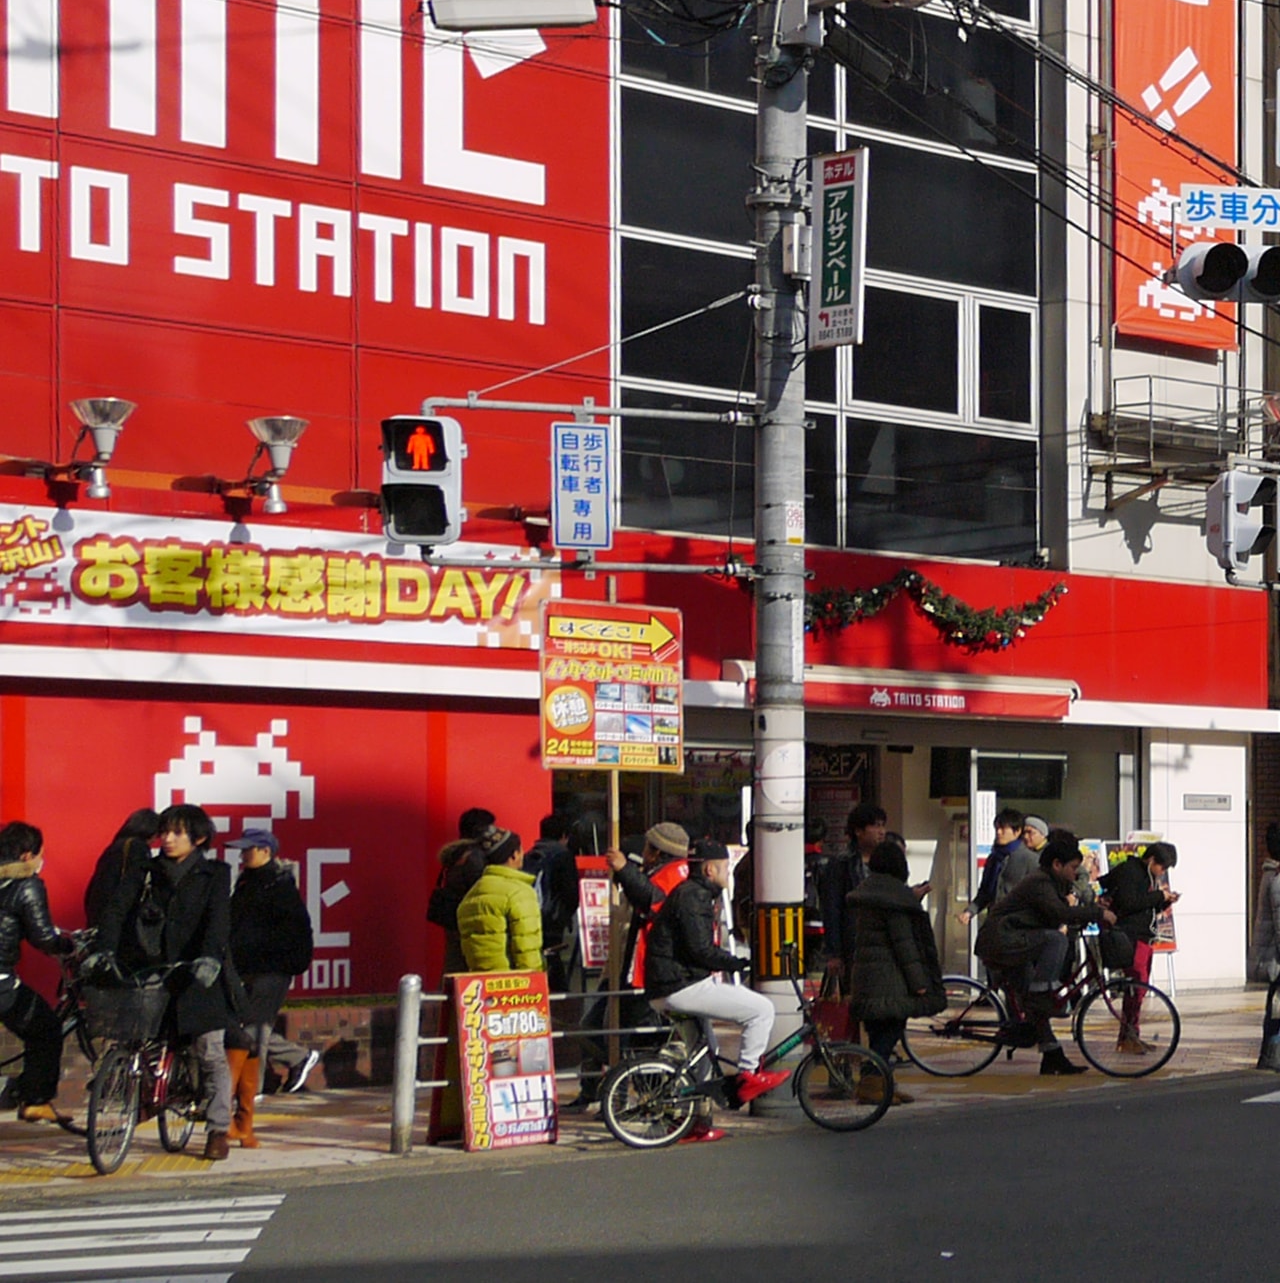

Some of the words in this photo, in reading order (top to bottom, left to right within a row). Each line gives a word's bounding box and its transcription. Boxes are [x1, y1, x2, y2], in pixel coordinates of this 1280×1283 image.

[824, 162, 854, 181] ホテル
[174, 182, 546, 326] STATION
[825, 189, 849, 304] アルサンベール
[560, 431, 581, 493] 自転車
[583, 430, 604, 494] 歩行者
[572, 497, 595, 543] 専用
[79, 538, 529, 621] お客様感謝DAY!
[552, 698, 589, 720] 休憩
[893, 690, 922, 707] TAITO
[924, 692, 966, 710] STATION
[546, 738, 571, 756] 24
